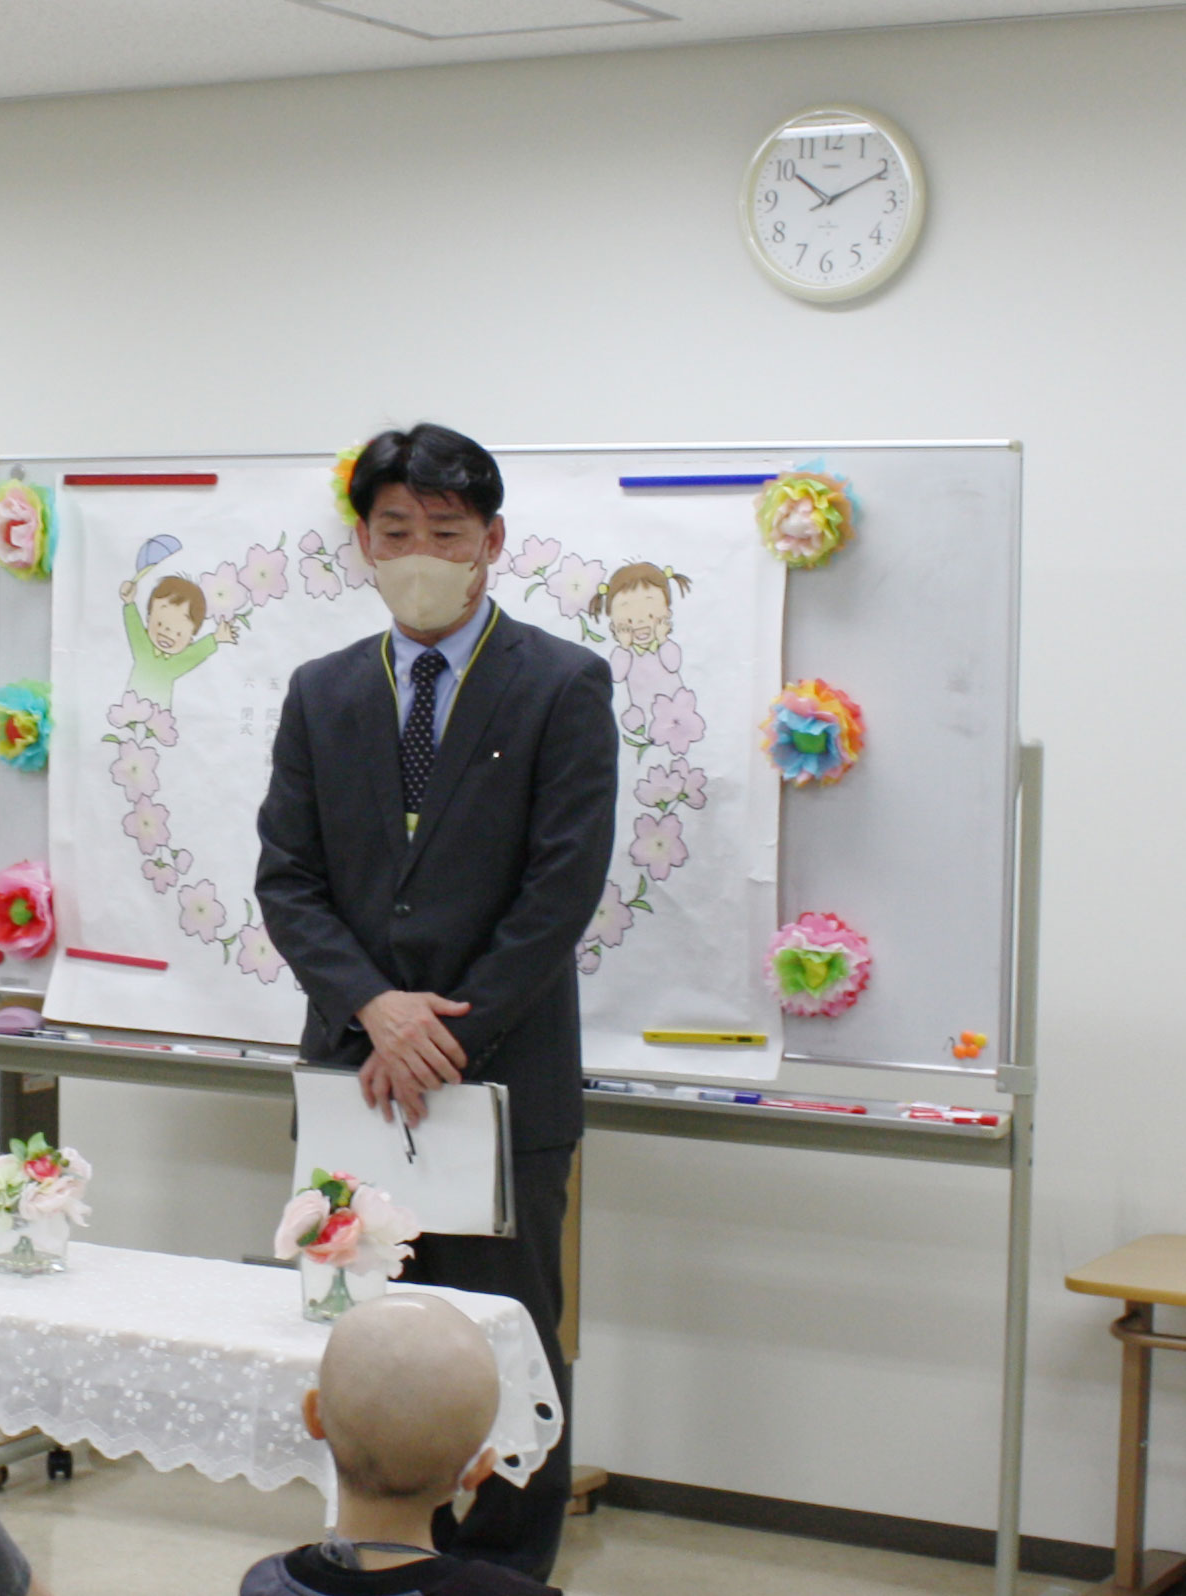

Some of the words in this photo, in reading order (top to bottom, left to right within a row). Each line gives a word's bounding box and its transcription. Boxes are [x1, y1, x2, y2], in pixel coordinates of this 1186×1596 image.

[798, 136, 815, 159] 11
[823, 130, 844, 150] 12
[859, 136, 866, 159] 1
[775, 158, 797, 182] 10
[874, 158, 888, 180] 2
[764, 190, 779, 213] 9
[883, 190, 897, 214] 3
[772, 220, 786, 243] 8
[869, 220, 882, 245] 4
[796, 243, 809, 267] 7
[819, 249, 833, 273] 6
[849, 243, 862, 267] 5
